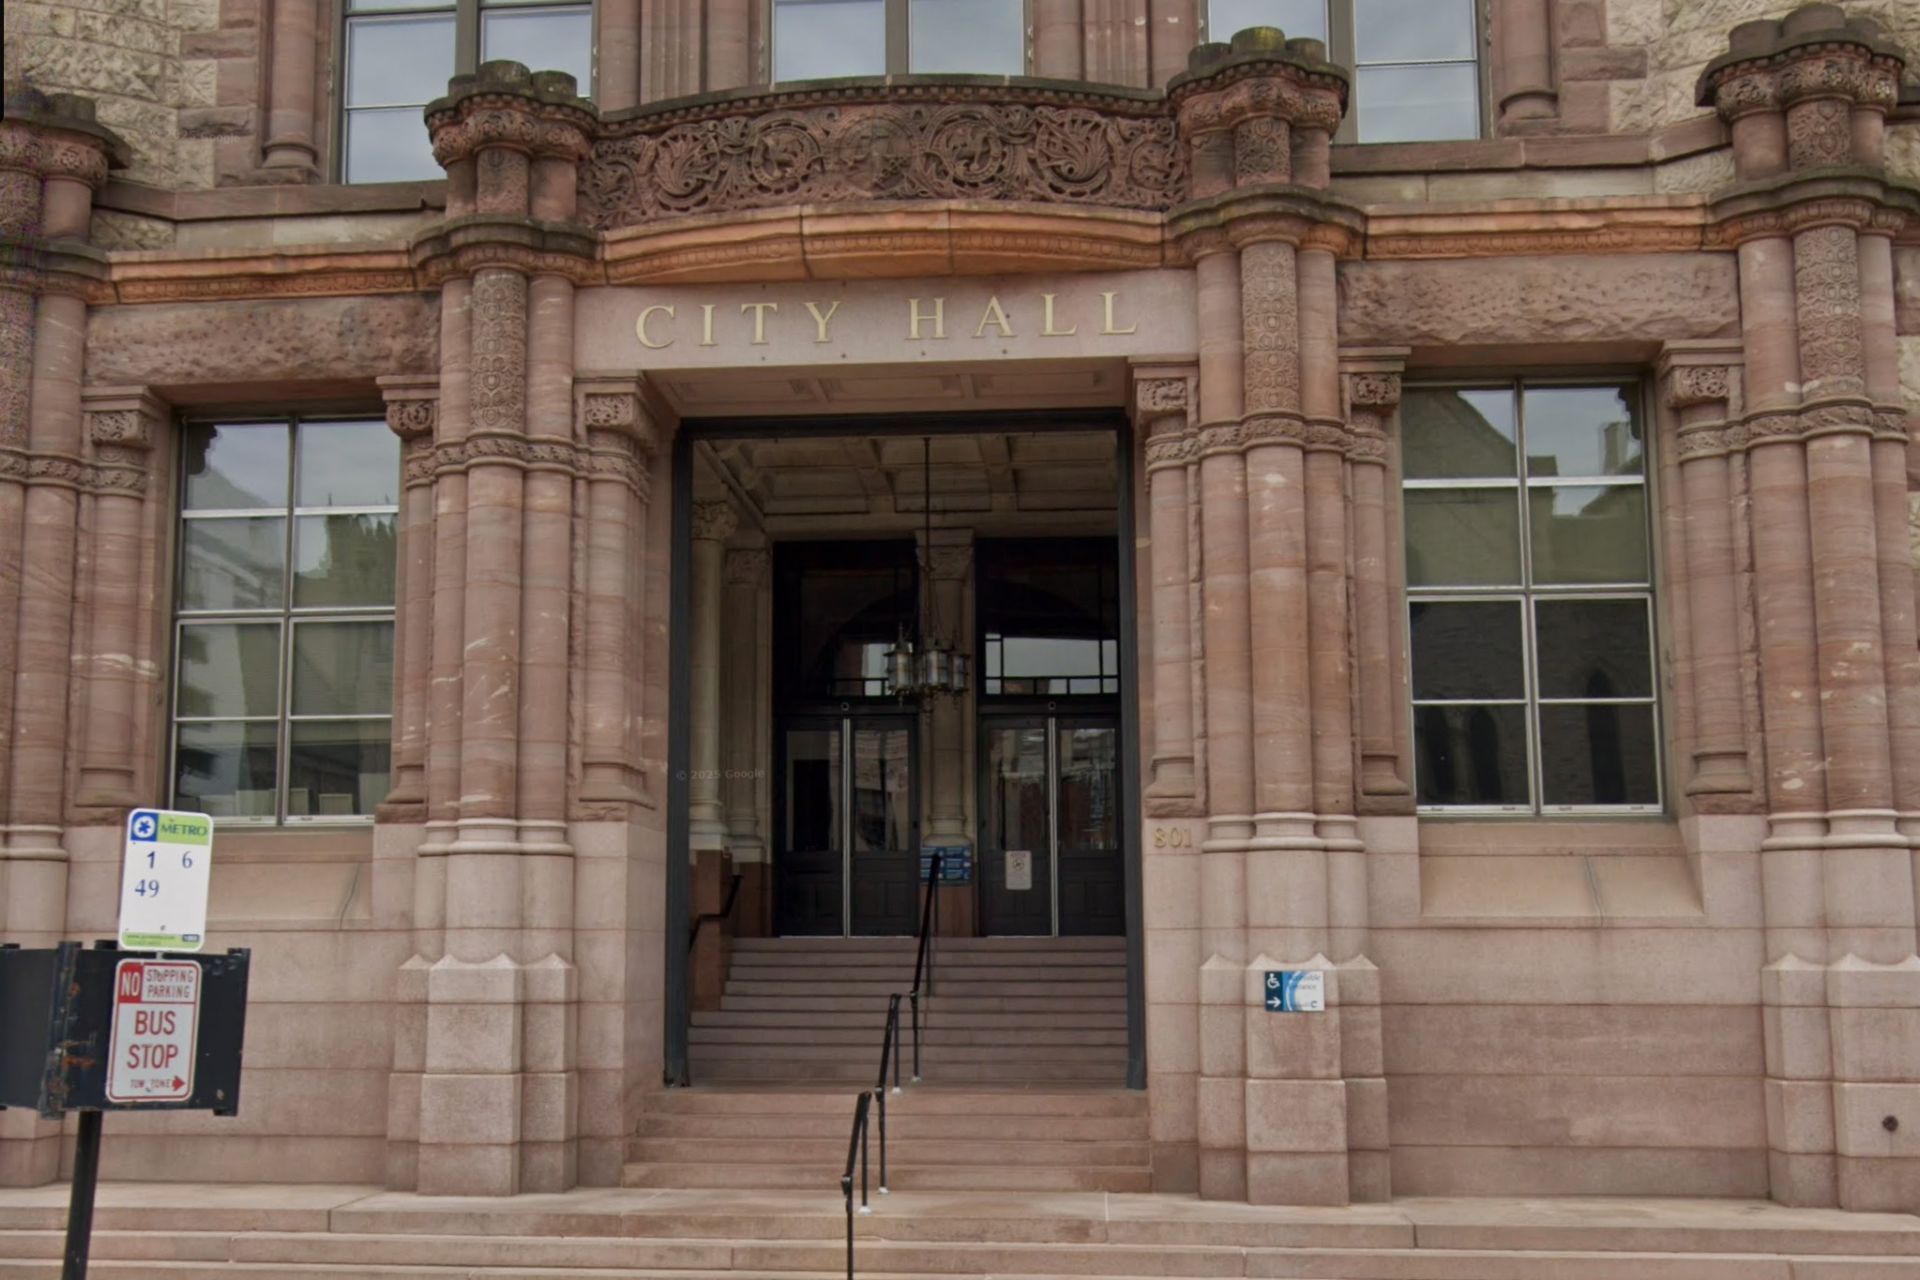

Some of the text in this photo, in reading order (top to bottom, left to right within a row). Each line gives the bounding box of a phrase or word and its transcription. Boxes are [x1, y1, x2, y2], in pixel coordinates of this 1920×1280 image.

[635, 290, 1139, 349] CITY HALL
[161, 823, 208, 836] METRO
[1153, 827, 1192, 848] 801
[147, 850, 193, 869] 1 6
[134, 879, 160, 898] 49
[121, 971, 140, 997] NO
[146, 968, 194, 983] STOPPING
[146, 984, 190, 998] PARKING
[135, 1010, 176, 1035] BUS
[127, 1043, 179, 1069] STOP
